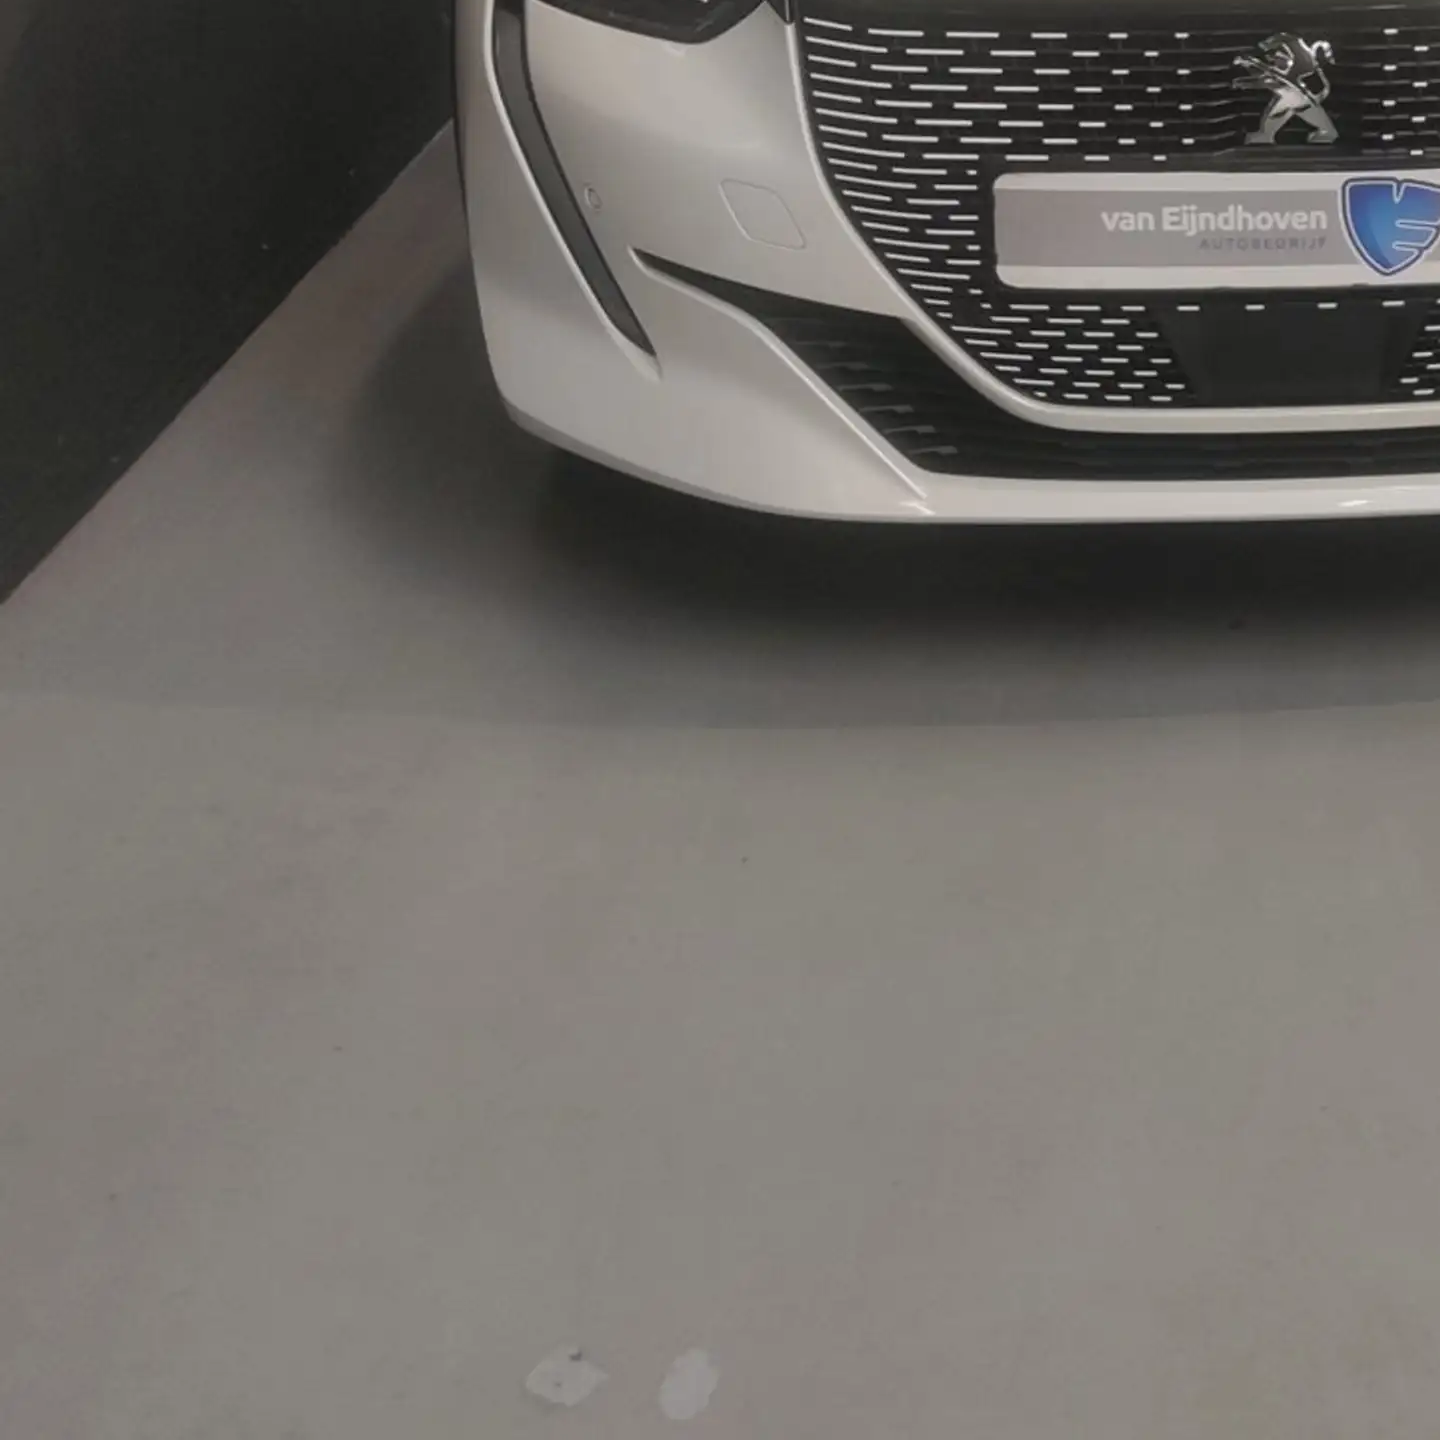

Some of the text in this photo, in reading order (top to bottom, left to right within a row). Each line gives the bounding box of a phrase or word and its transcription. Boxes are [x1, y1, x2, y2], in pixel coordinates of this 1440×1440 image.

[1101, 206, 1328, 237] van Eijndhoven
[1199, 236, 1328, 251] AUTOBEDRIJF
